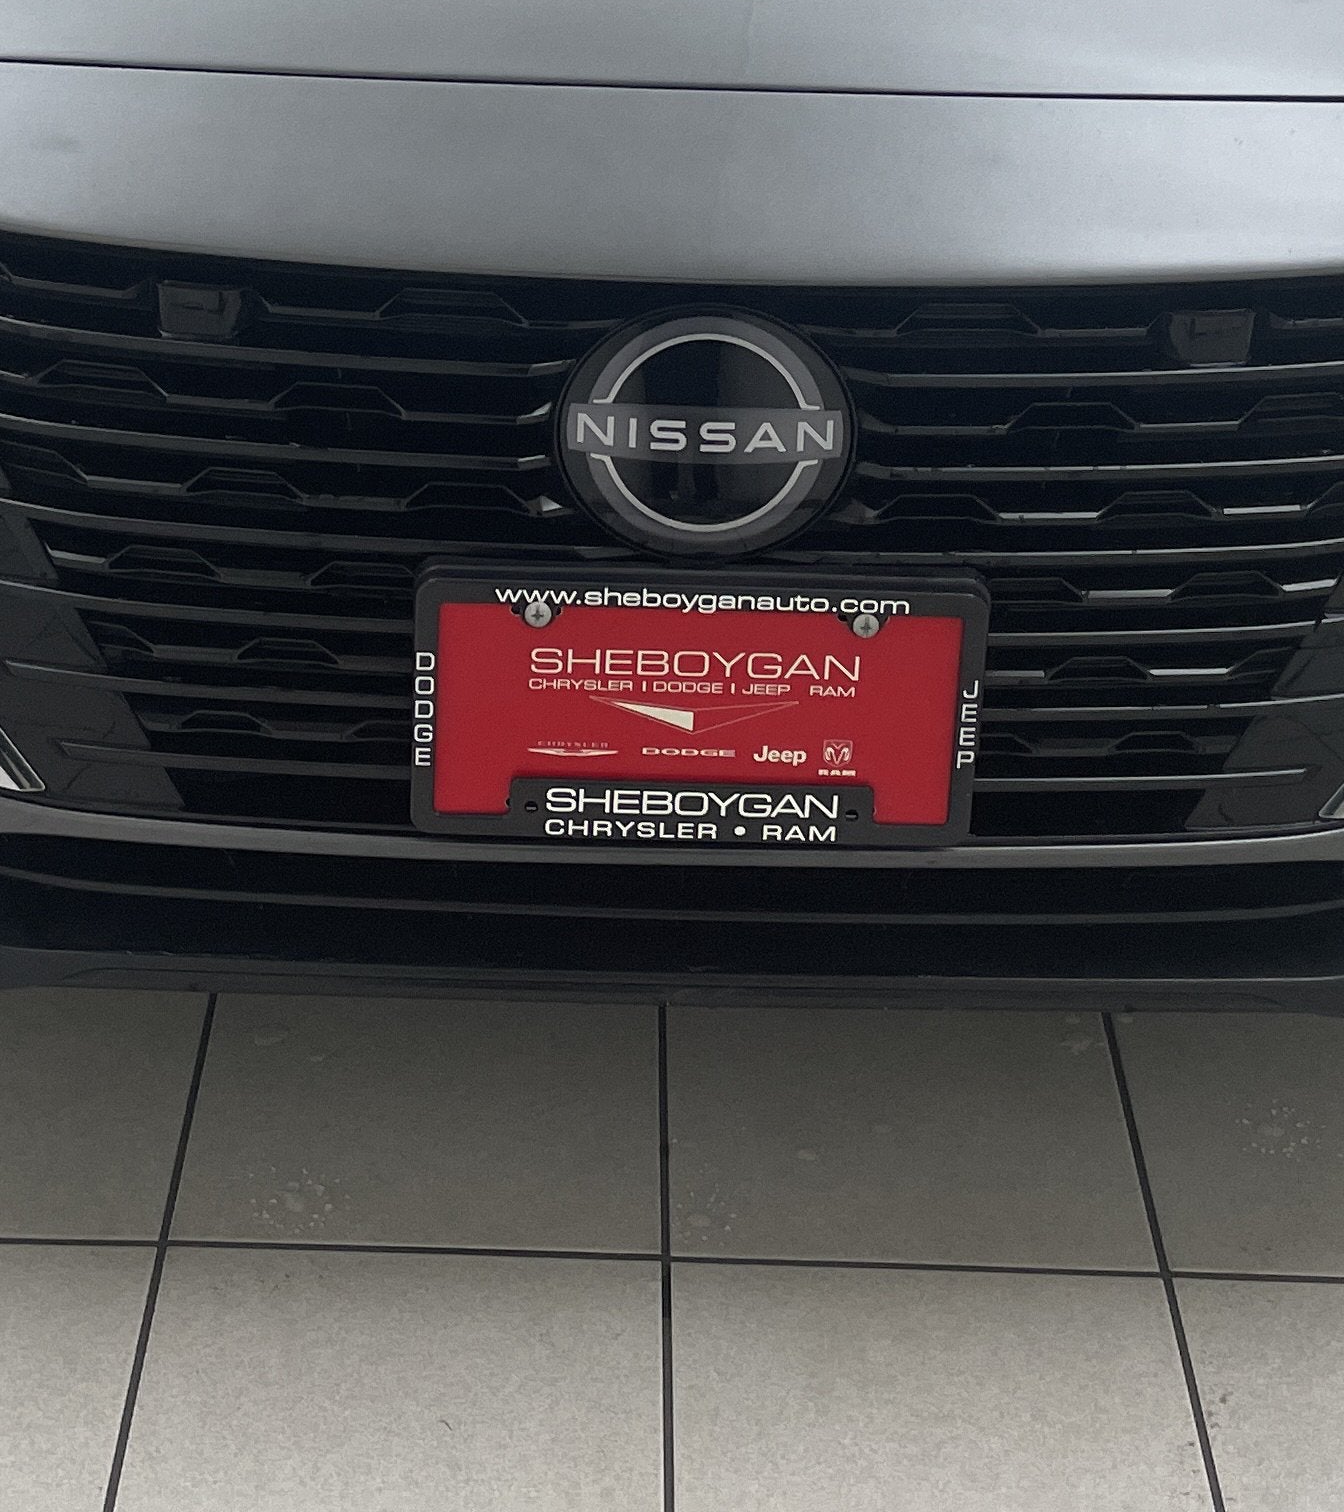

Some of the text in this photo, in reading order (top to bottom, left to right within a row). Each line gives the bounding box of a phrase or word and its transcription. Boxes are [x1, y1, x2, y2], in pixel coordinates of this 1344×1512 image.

[576, 412, 834, 453] NISSAN
[494, 588, 910, 615] www.sheboyganauto.com
[530, 648, 860, 681] SHEBOYGAN
[528, 678, 856, 698] CHRYSLER DODGE JEEP RAM
[414, 652, 435, 766] DODGE
[956, 680, 979, 769] JEEP
[642, 747, 735, 757] DODGE
[753, 745, 807, 766] Jeep
[545, 787, 839, 819] SHEBOYGAN
[544, 819, 836, 842] CHRYSLER RAM
